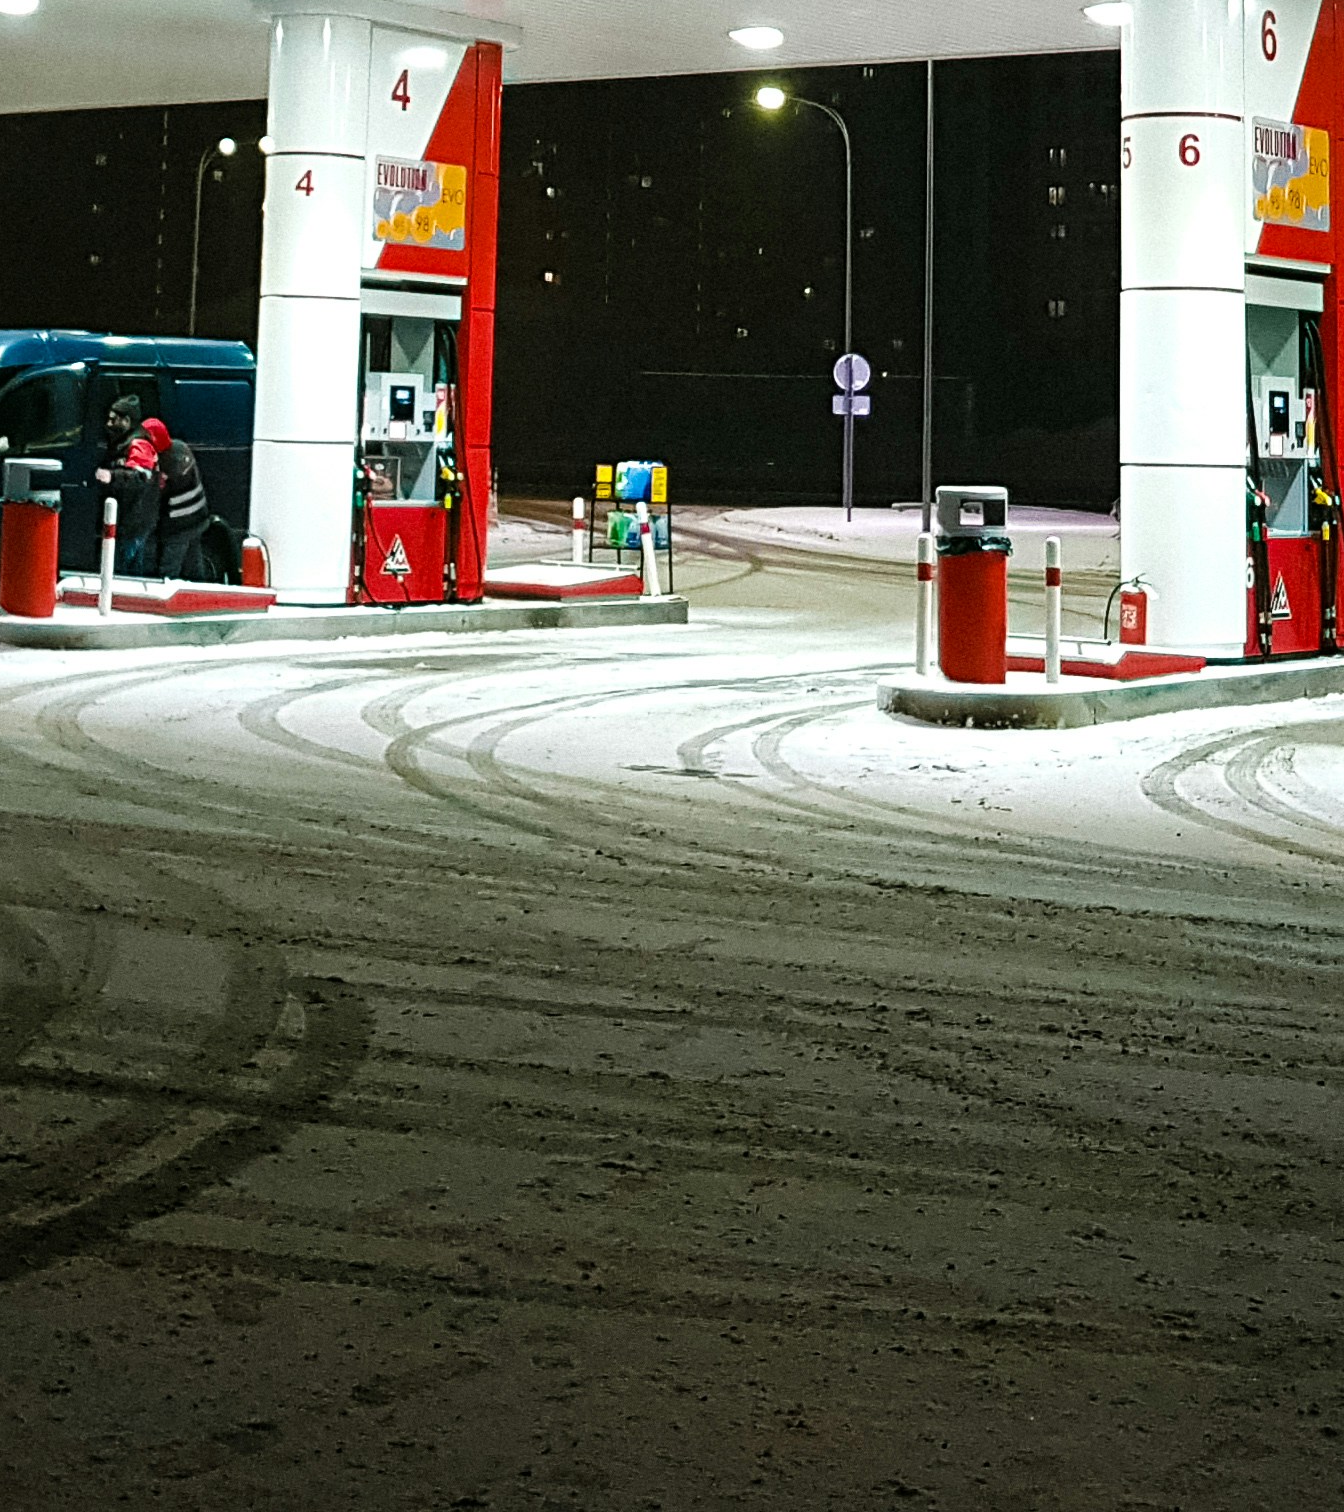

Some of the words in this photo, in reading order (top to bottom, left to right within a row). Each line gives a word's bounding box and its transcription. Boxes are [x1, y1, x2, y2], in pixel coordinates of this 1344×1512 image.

[1261, 9, 1278, 62] 6
[391, 69, 411, 112] 4
[1178, 133, 1201, 167] 6
[294, 169, 315, 197] 4
[442, 188, 465, 206] EVO
